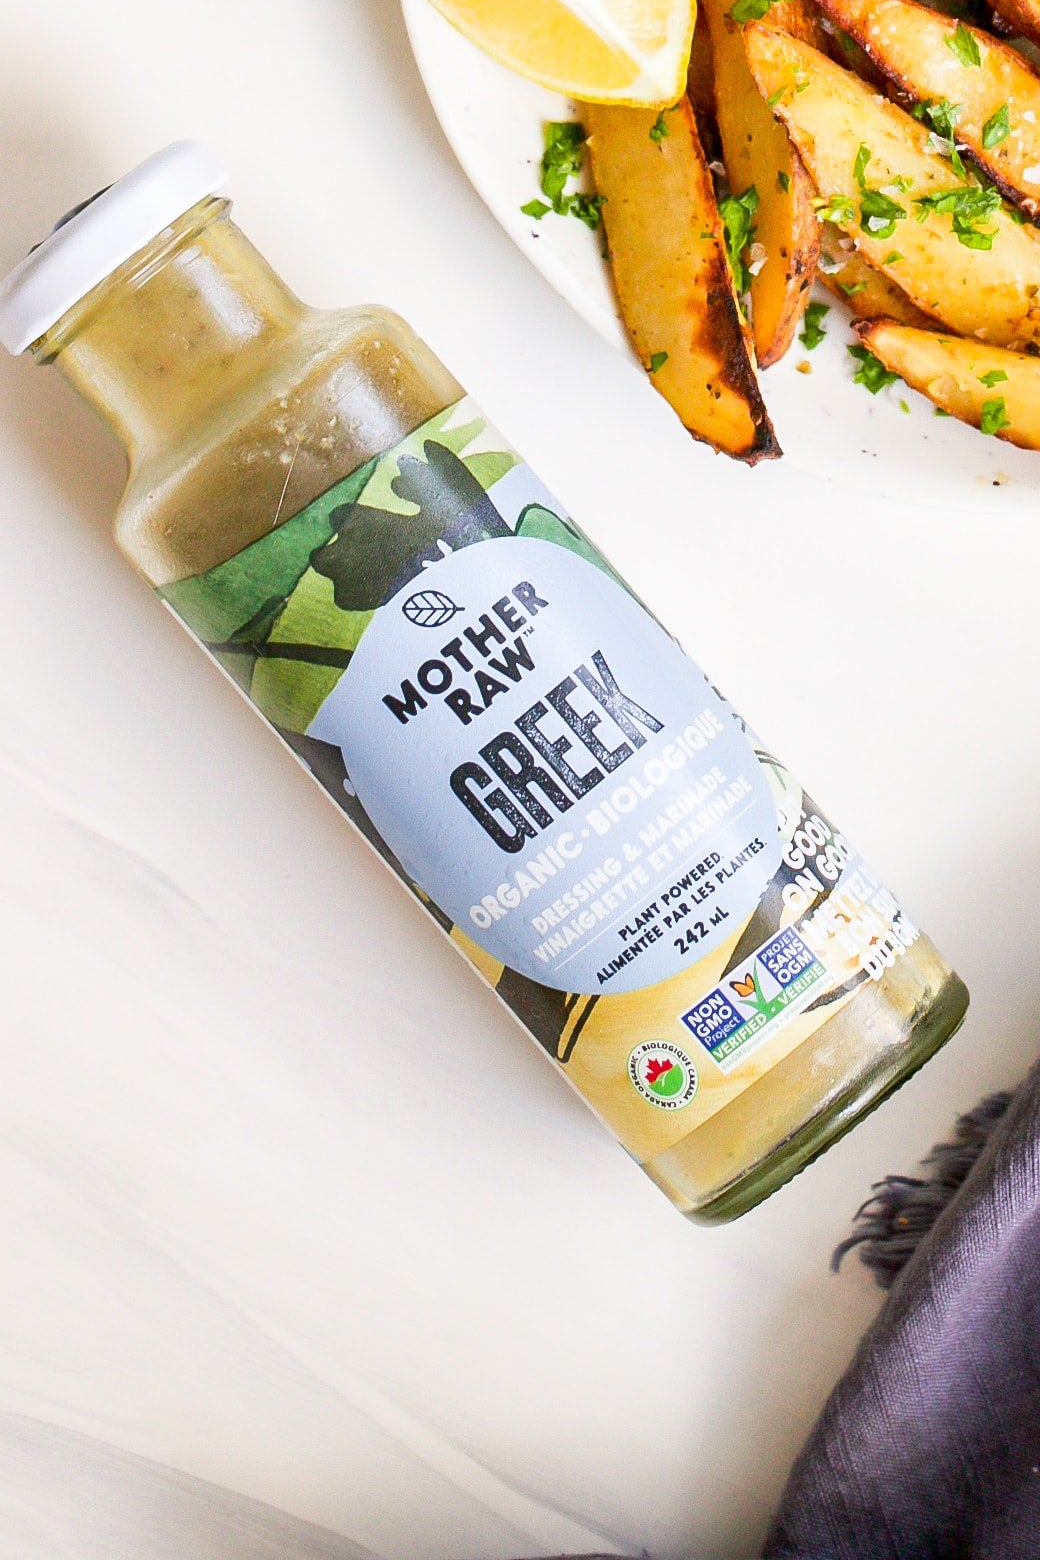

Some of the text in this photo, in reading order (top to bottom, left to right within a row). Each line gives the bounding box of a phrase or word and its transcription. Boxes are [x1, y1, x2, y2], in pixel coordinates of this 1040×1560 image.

[382, 581, 549, 725] MOTHER
[444, 636, 536, 726] RAW
[449, 650, 666, 854] GREEK
[468, 708, 725, 930] ORGANIC BIOLOGIQUE
[781, 814, 832, 871] GOOD
[531, 856, 623, 936] DRESSING
[622, 842, 642, 863] &
[638, 765, 727, 848] MARINADE
[533, 864, 650, 963] VINAIGRETTE
[647, 842, 675, 873] ET
[671, 773, 753, 853] MARINADE
[617, 851, 725, 942] PLANT POWERED.
[781, 867, 825, 912] ON
[595, 924, 664, 986] ALIMENTÉE
[662, 901, 693, 929] PAR
[690, 880, 717, 906] LES
[673, 920, 711, 956] 242
[760, 929, 796, 963] PROJET
[766, 938, 805, 975] SANS
[858, 936, 896, 982] DU
[777, 950, 814, 985] OGM
[687, 993, 725, 1028] NON
[696, 1005, 733, 1038] GMO
[704, 1015, 741, 1048] Project
[711, 1013, 768, 1060] VERIFIED
[629, 1055, 677, 1108] CANADA ORGANIC
[641, 1042, 696, 1101] BIOLOGIQUE CANADA
